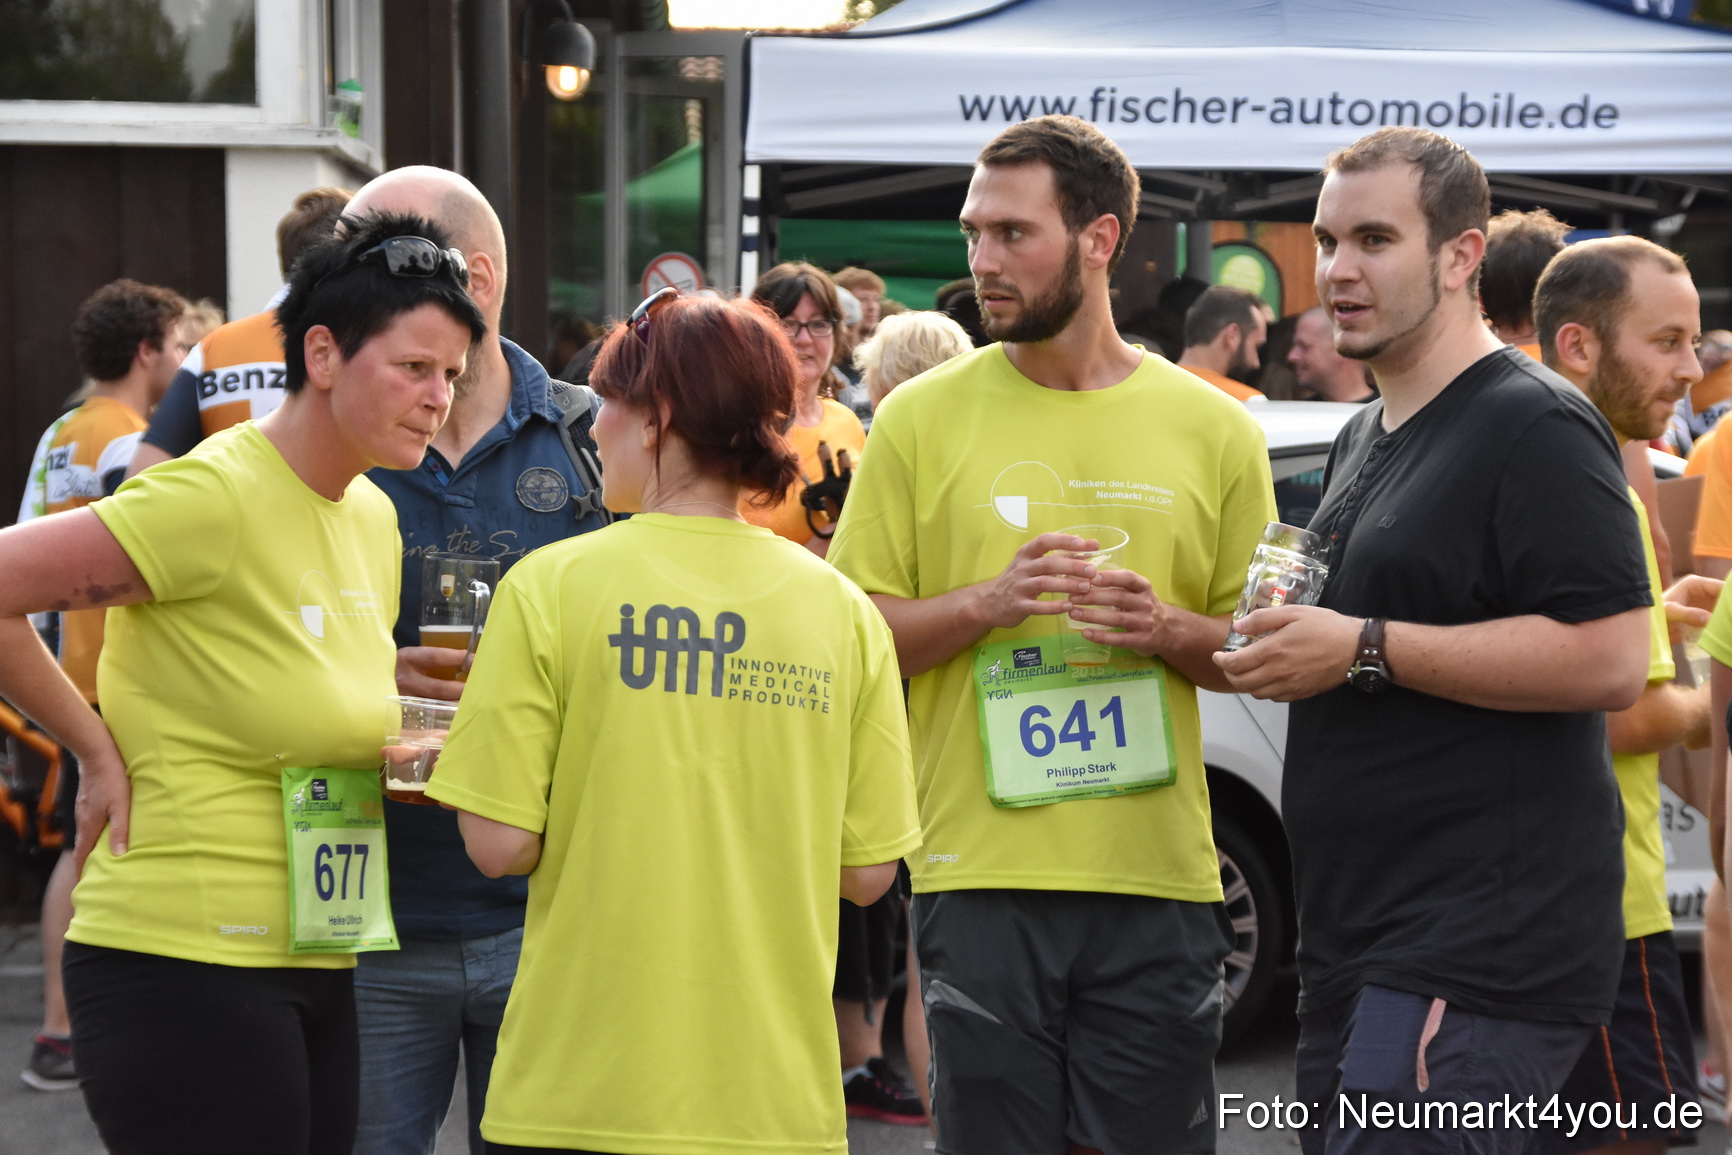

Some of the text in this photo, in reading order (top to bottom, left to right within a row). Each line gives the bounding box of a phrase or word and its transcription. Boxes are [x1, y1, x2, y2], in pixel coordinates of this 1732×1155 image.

[959, 87, 1620, 130] www.fischer-automobile.de
[1068, 479, 1175, 496] Kliniken des Landkreises
[1096, 490, 1142, 501] Neumarkt
[446, 524, 483, 554] the
[731, 657, 831, 683] INNOVATIVE
[1003, 662, 1068, 680] firmenlauf
[730, 673, 830, 698] MEDICAL
[728, 688, 829, 714] PRODUKTE
[1019, 695, 1127, 758] 641
[1046, 762, 1117, 779] Philipp Stark
[1056, 777, 1110, 788] Klinikum Neumarkt
[927, 854, 959, 863] SPIRO
[314, 843, 369, 902] 677
[328, 915, 346, 926] Heike
[219, 925, 269, 936] SPIRO
